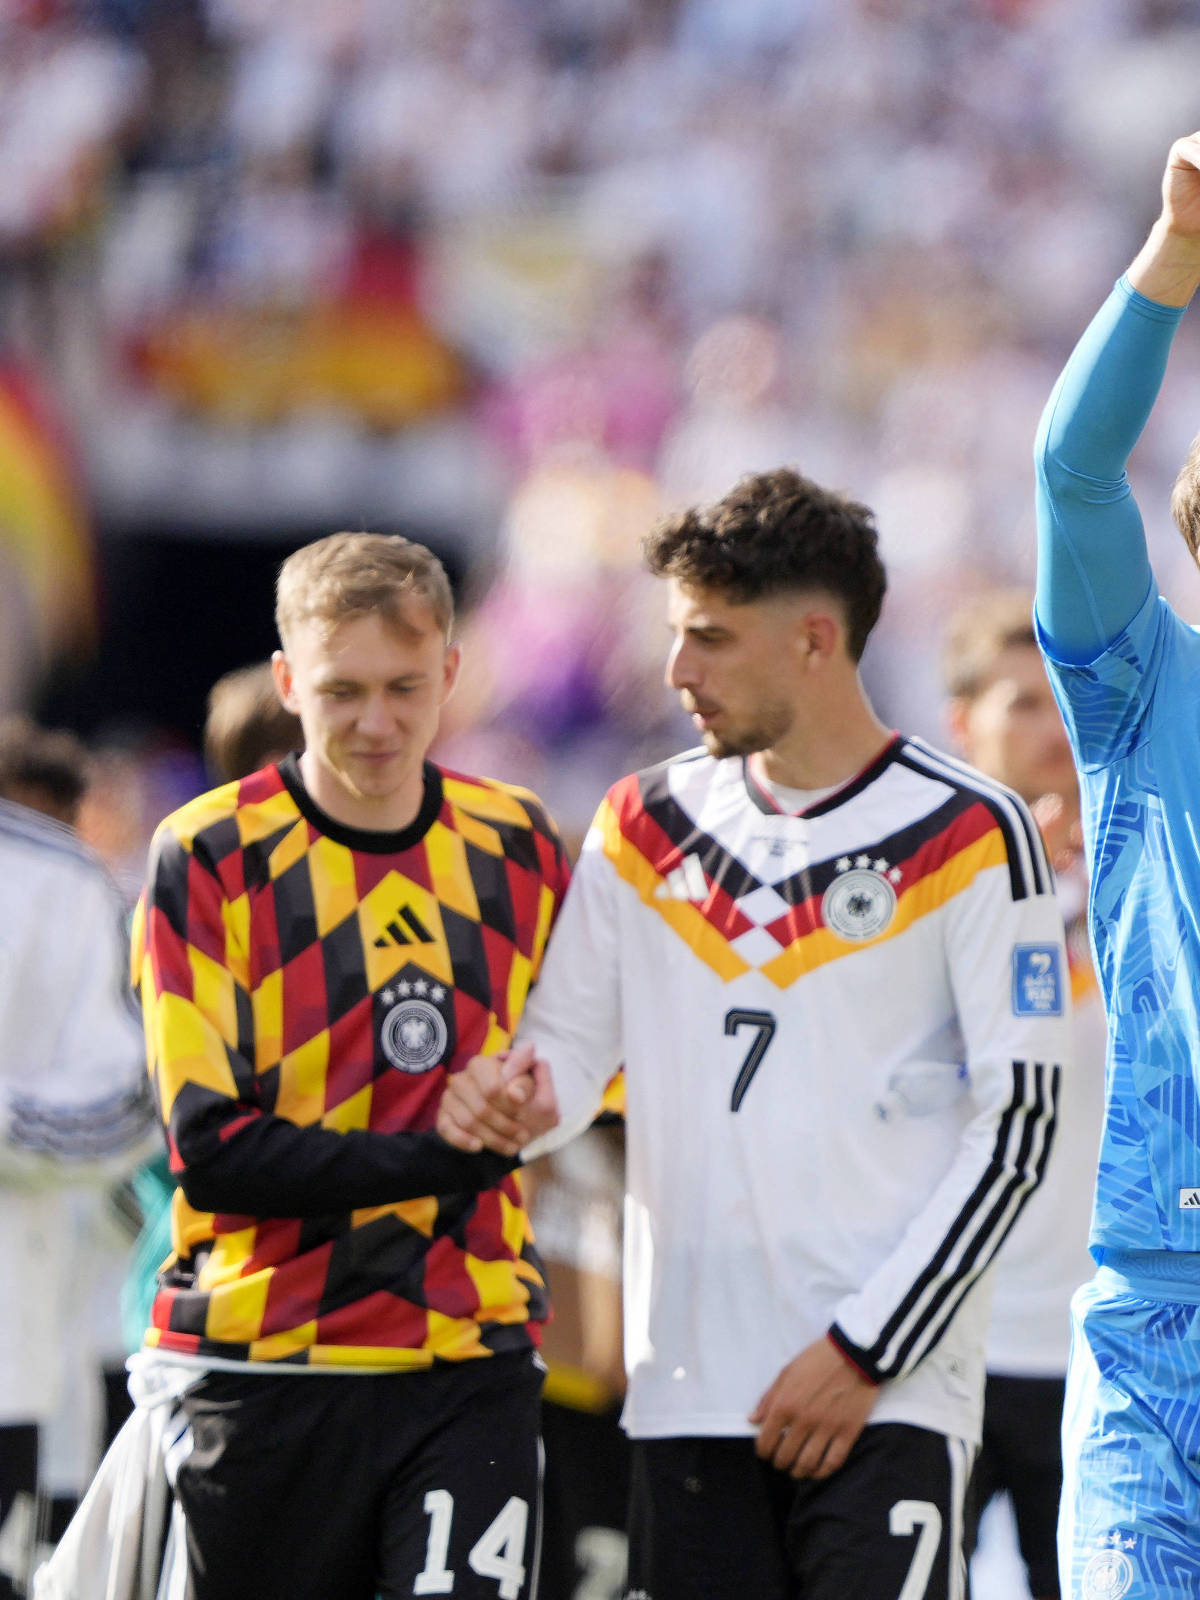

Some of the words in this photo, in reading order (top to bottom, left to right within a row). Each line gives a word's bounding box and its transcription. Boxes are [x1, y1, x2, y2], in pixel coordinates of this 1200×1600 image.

[723, 1007, 777, 1113] 7
[413, 1489, 529, 1600] 14
[889, 1500, 942, 1600] 7
